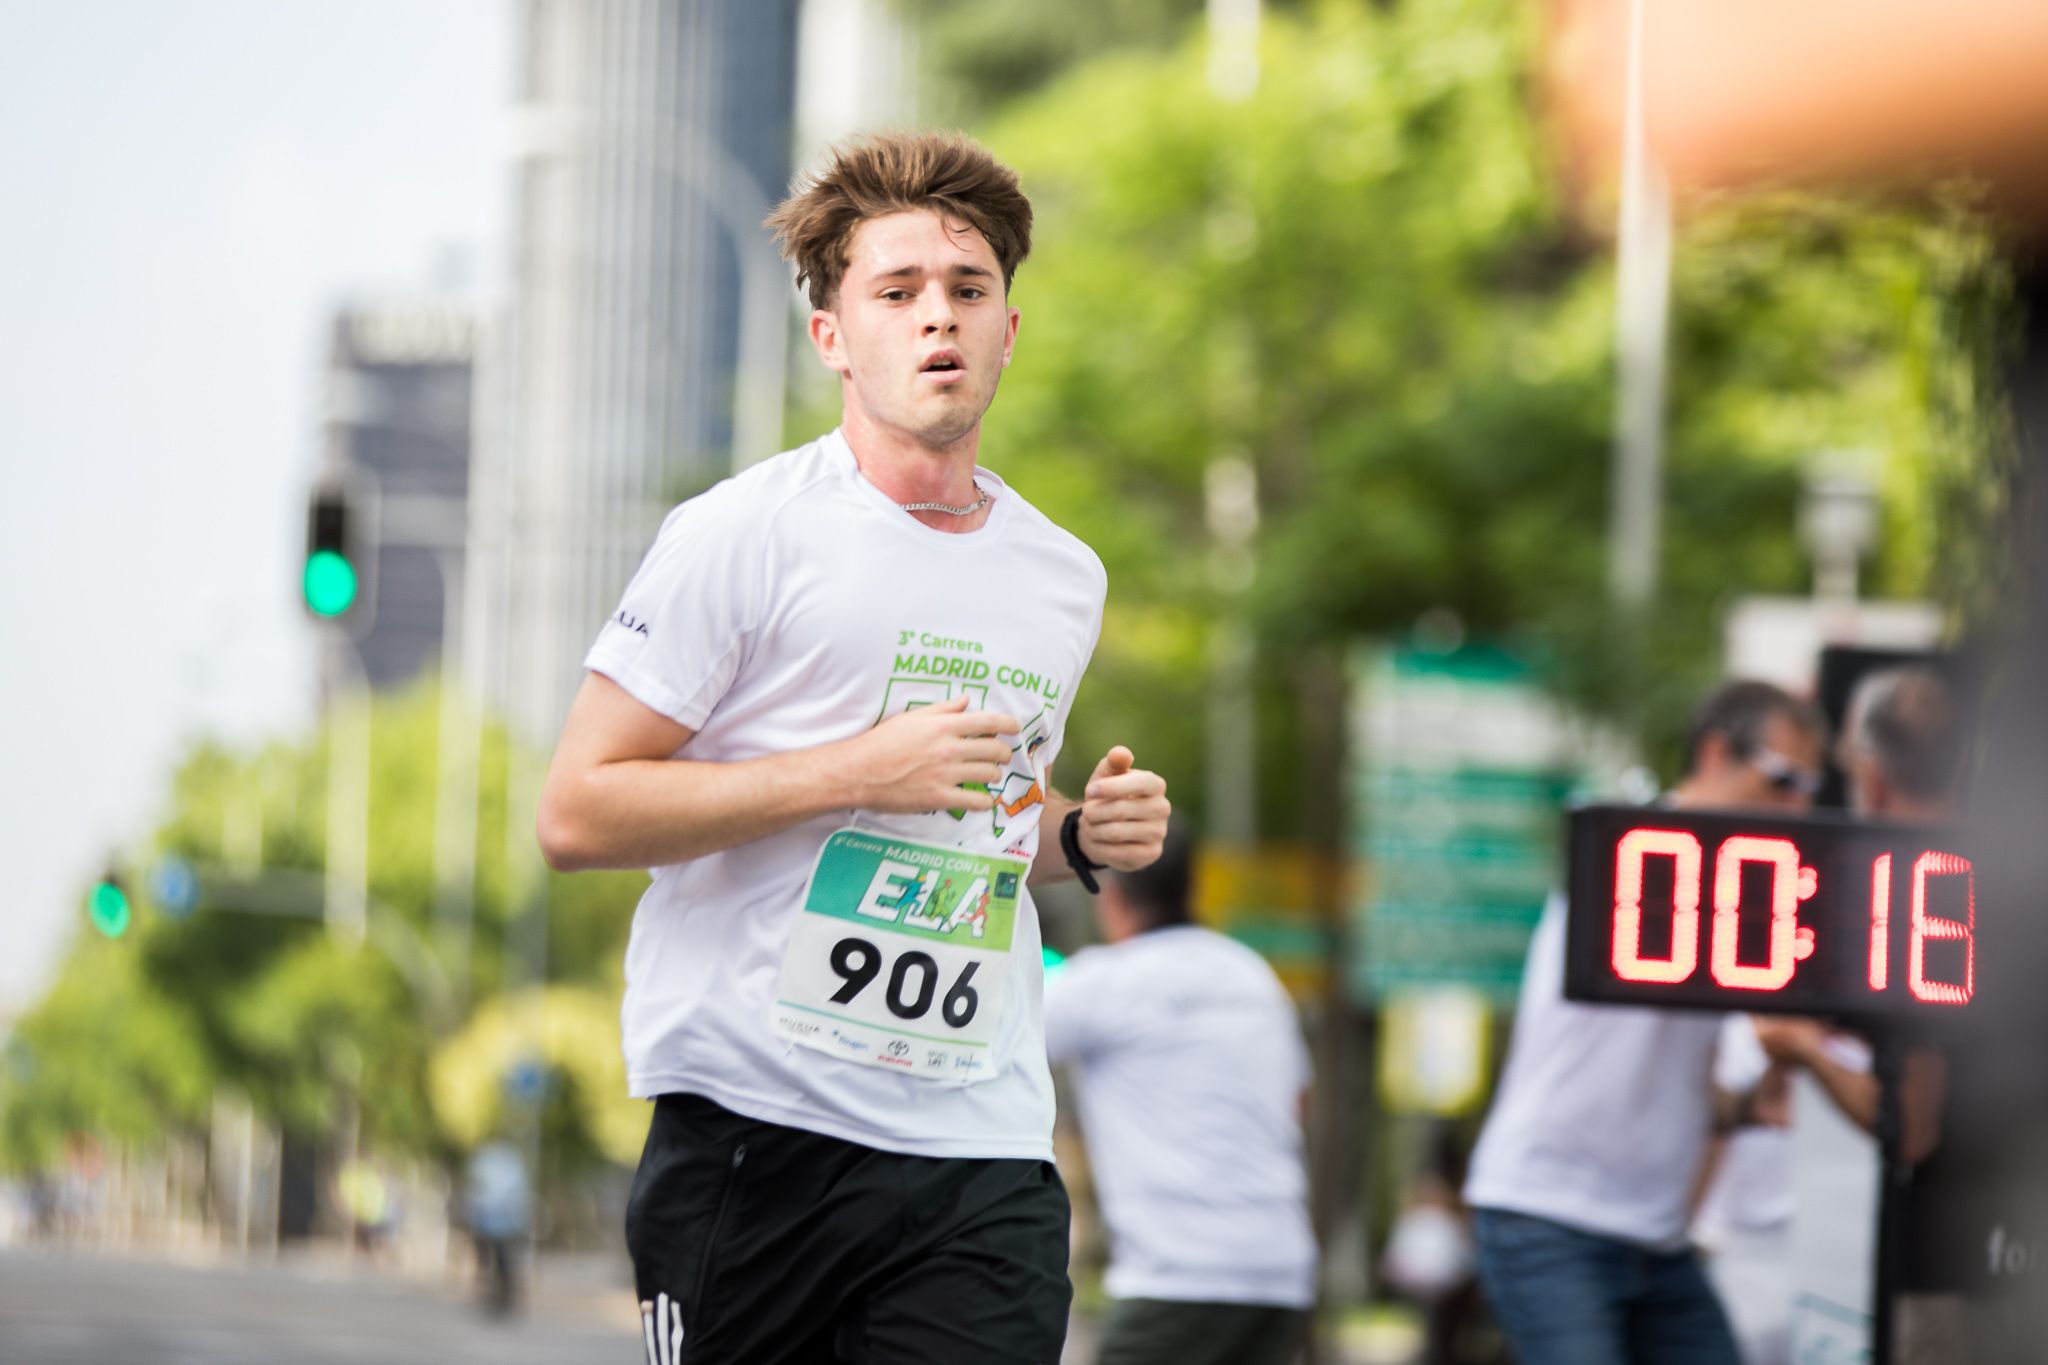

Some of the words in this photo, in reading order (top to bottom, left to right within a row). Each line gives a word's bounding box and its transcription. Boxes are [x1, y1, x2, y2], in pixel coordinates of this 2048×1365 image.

[920, 632, 983, 653] Carrera
[892, 653, 989, 680] MADRID
[996, 666, 1041, 692] CON
[884, 846, 944, 868] MADRID
[945, 858, 974, 873] CON
[973, 864, 990, 876] LA
[856, 859, 989, 938] ELA
[828, 937, 981, 1028] 906
